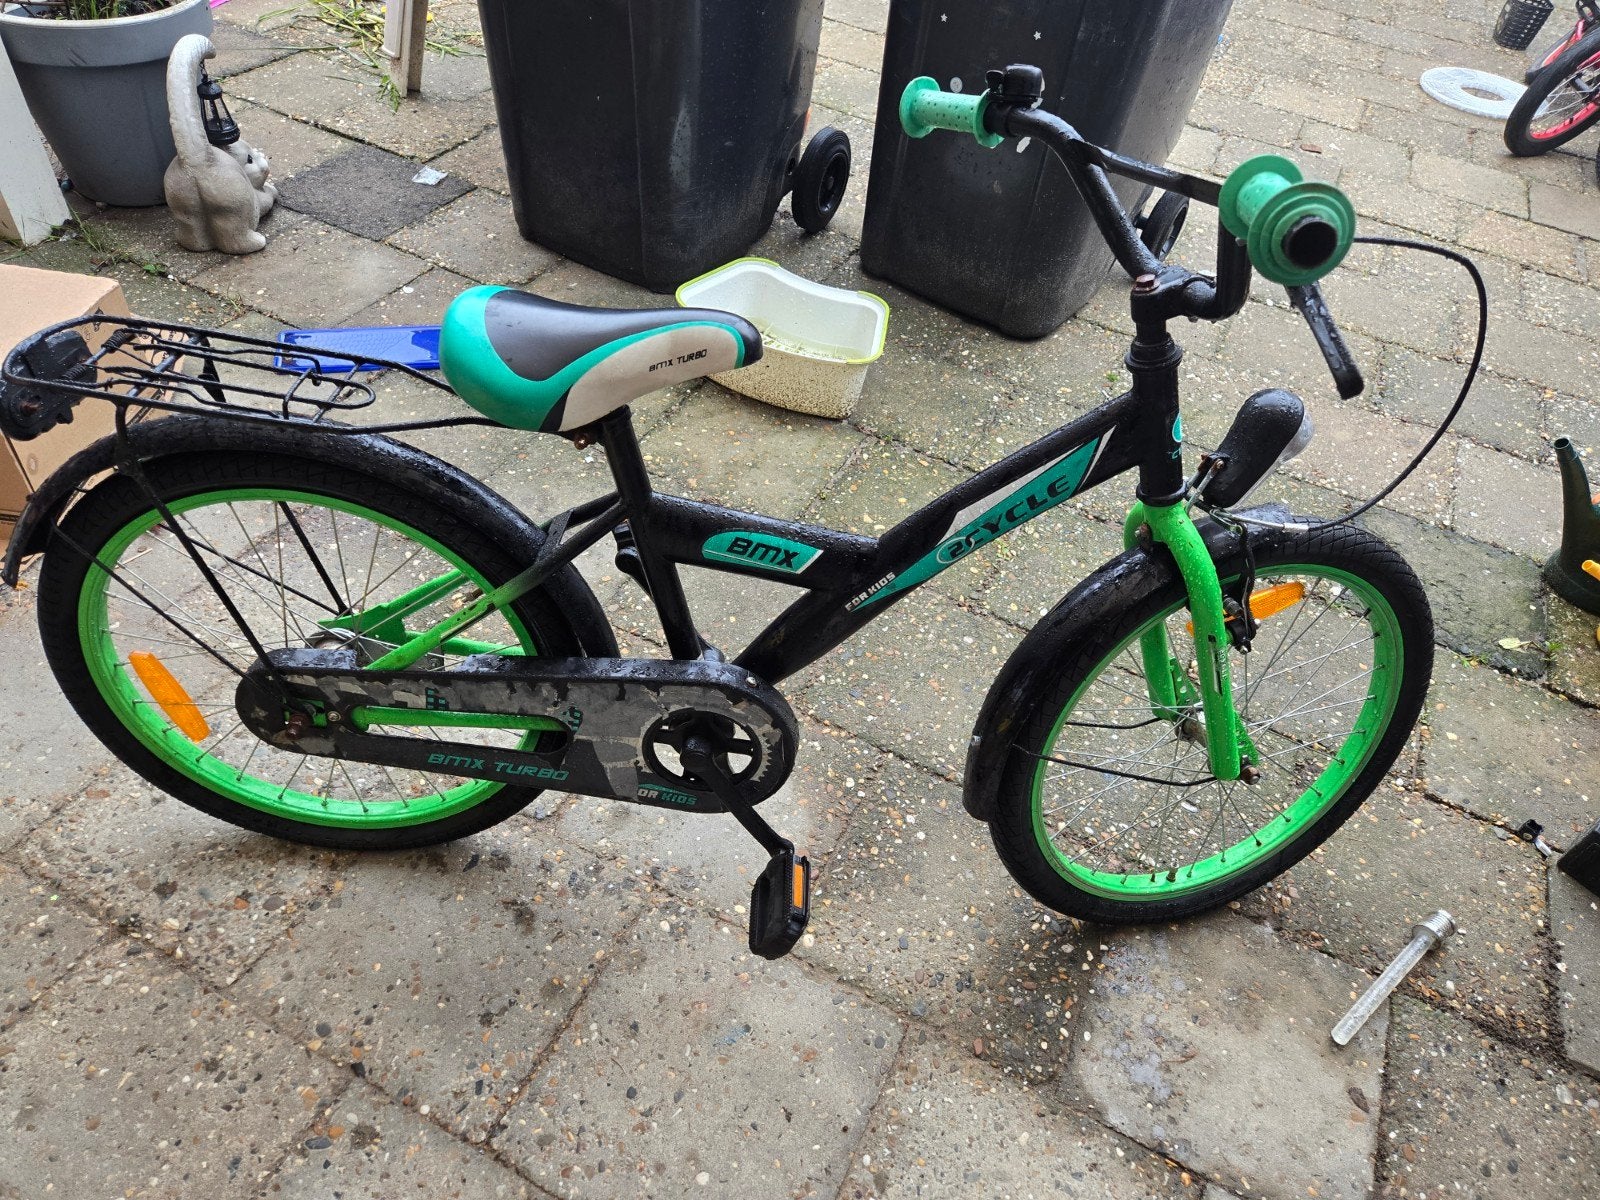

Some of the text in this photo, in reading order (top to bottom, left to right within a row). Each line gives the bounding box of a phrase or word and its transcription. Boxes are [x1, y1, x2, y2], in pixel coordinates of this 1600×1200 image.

[676, 349, 707, 365] TURBO
[726, 536, 799, 568] BMX
[845, 572, 896, 610] FOR KIDS
[495, 761, 570, 781] TURBO
[661, 792, 698, 805] KIDS
